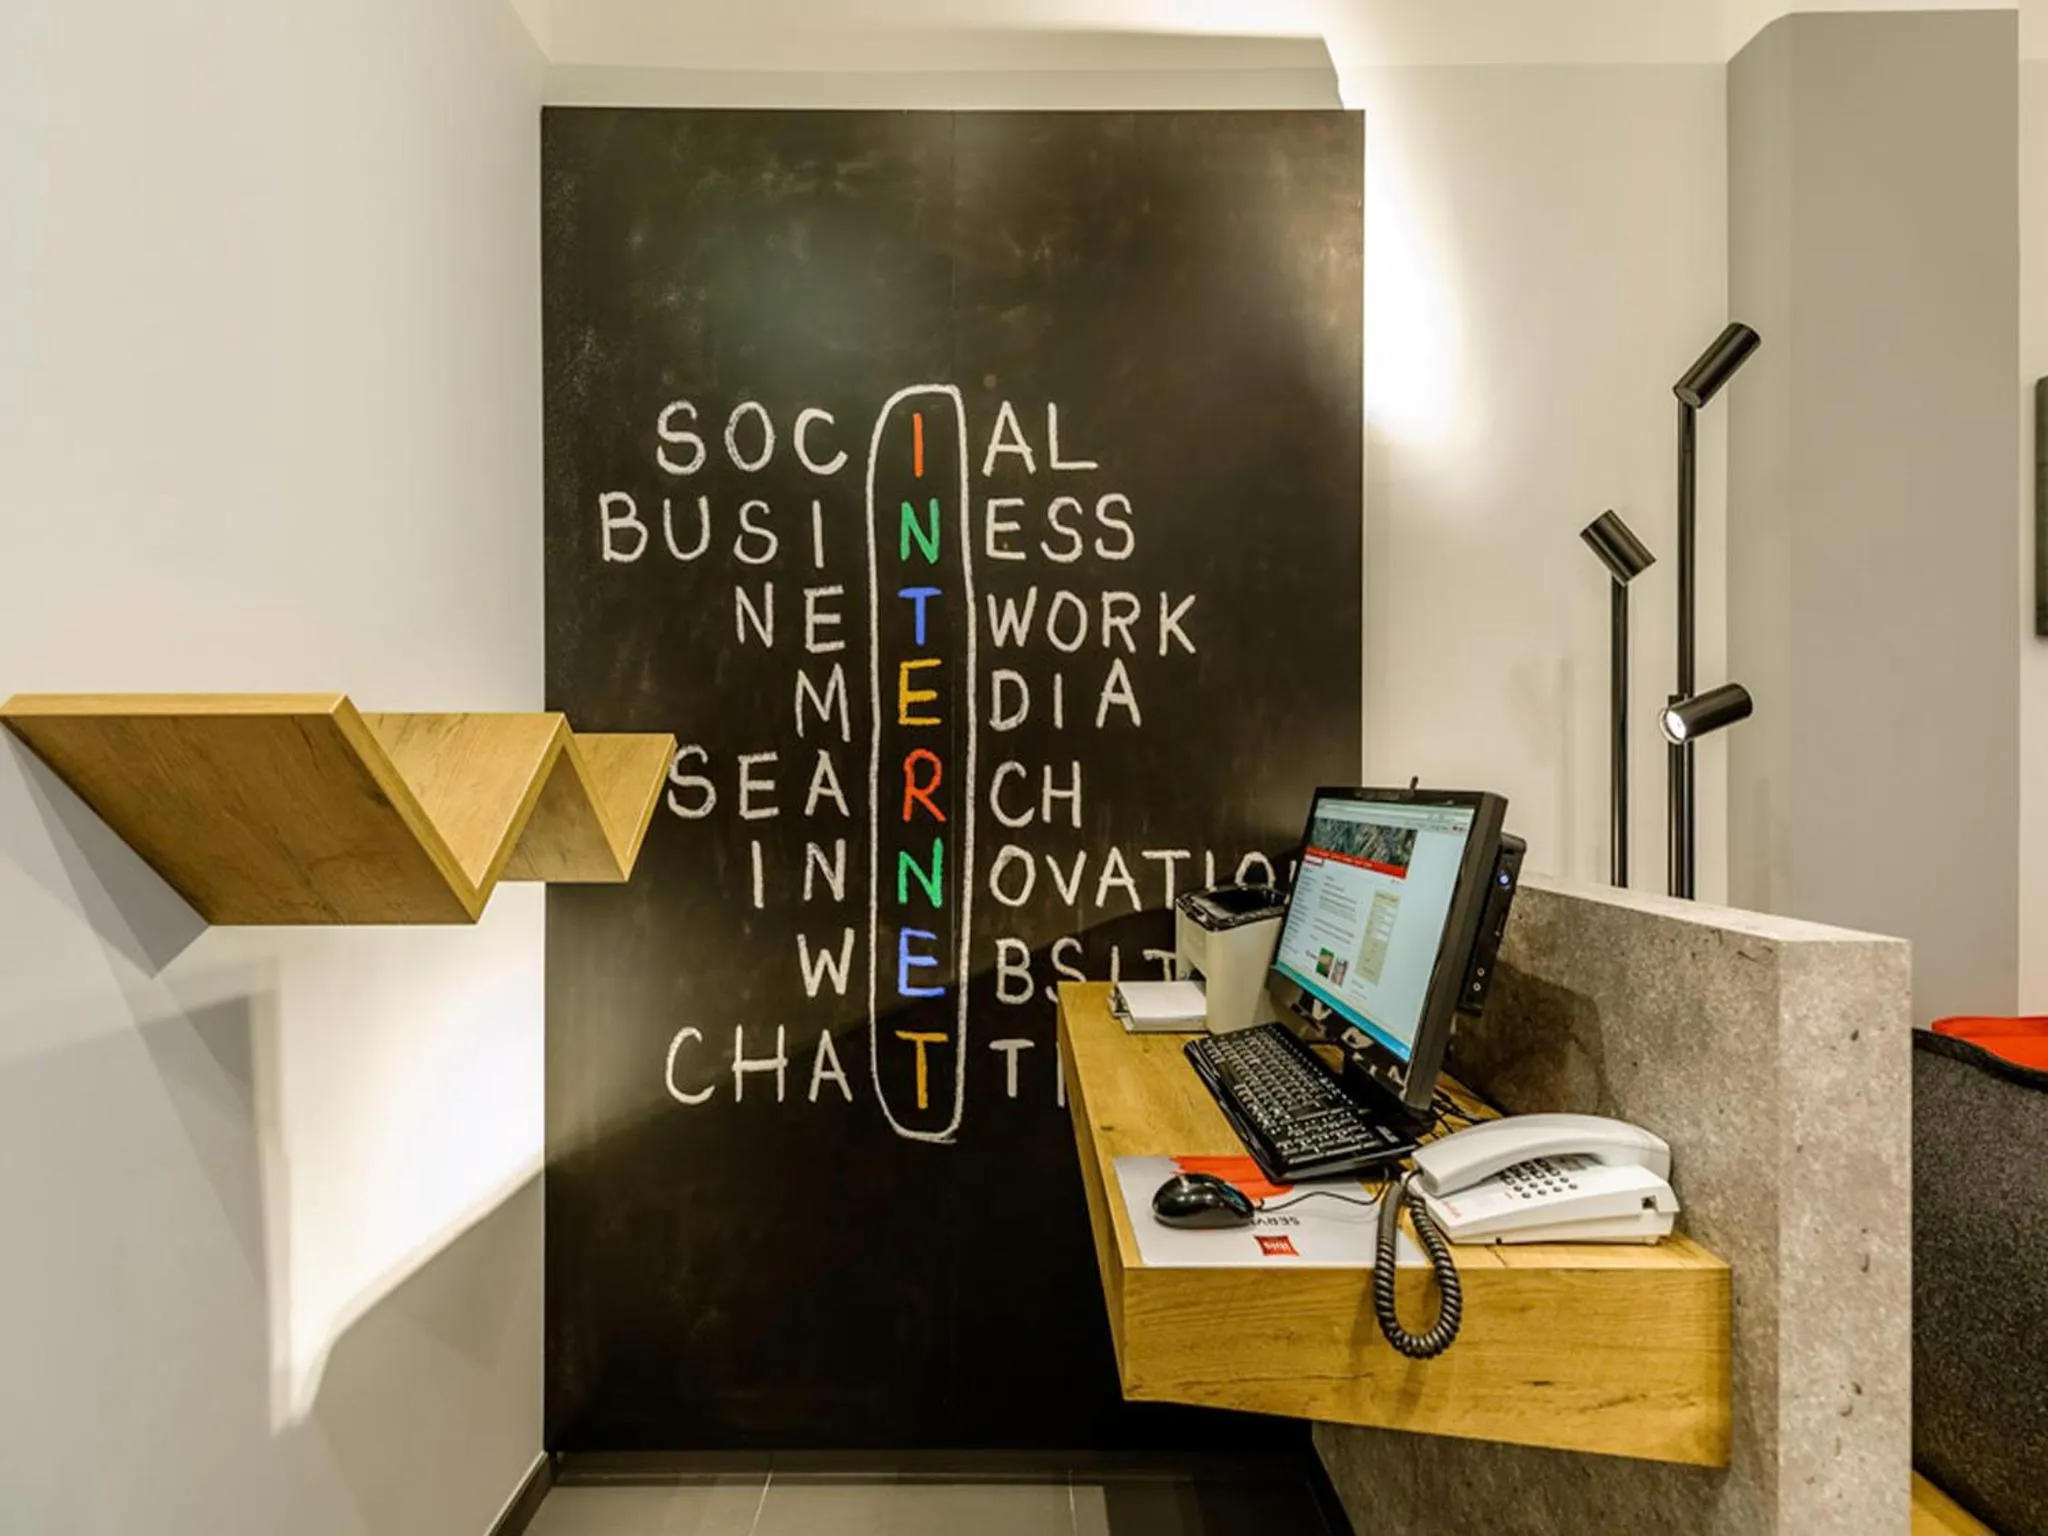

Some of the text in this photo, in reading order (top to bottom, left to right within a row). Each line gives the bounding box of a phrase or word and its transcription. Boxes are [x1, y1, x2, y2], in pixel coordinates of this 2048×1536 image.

[656, 400, 1100, 478] SOCIAL
[599, 492, 1136, 568] BUSINESS
[735, 582, 1197, 656] NETWORK
[795, 658, 1142, 742] MEDIA
[667, 744, 1082, 828] SEARCH
[752, 838, 1297, 911] INNOVATIO
[797, 928, 1177, 1003] WEBSIT
[664, 1026, 1065, 1110] CHATTI
